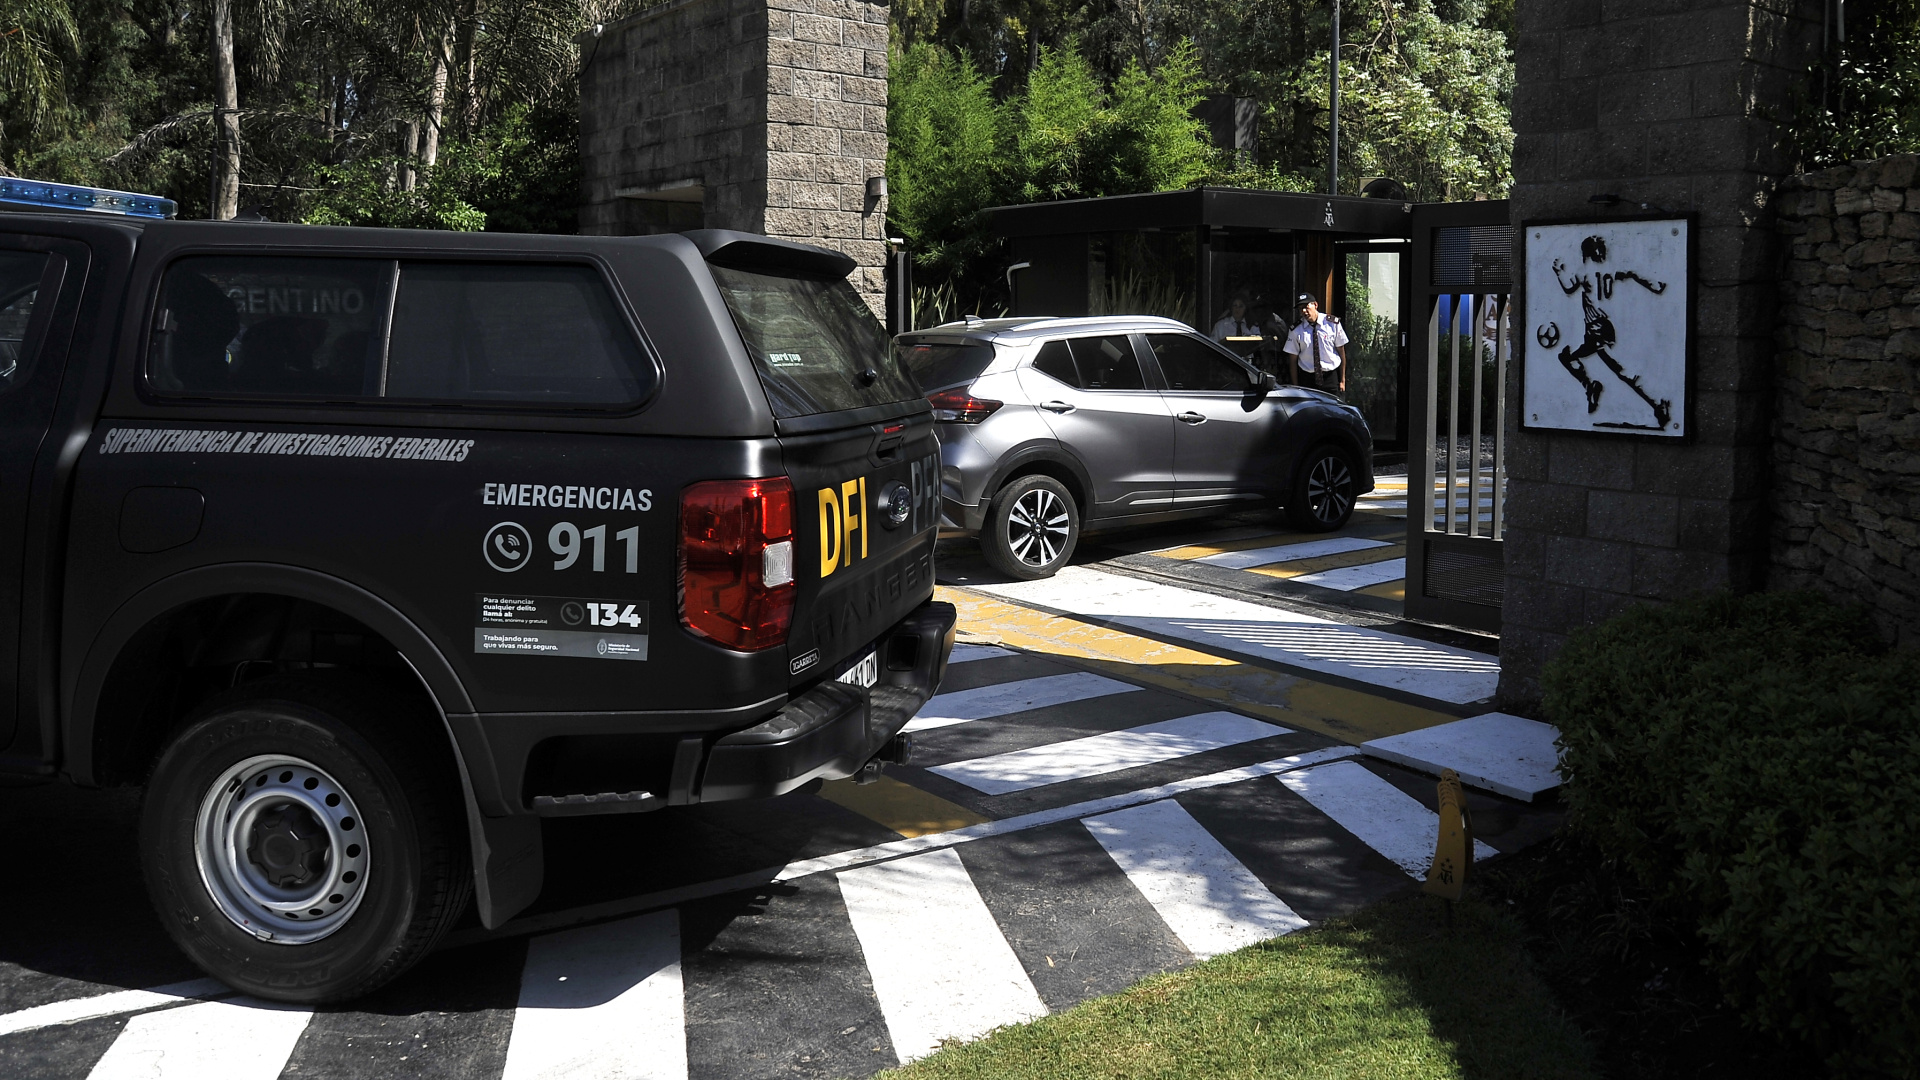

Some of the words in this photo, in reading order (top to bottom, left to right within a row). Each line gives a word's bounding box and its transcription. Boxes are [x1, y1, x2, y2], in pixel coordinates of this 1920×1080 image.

[227, 286, 364, 314] GENTINO
[1595, 272, 1613, 300] 10
[100, 427, 236, 454] SUPERINTENDENCIA
[235, 432, 257, 453] DE
[255, 432, 392, 458] INVESTIGACIONES
[386, 436, 474, 462] FEDERALES
[483, 482, 653, 512] EMERGENCIAS
[817, 476, 869, 579] DFI
[547, 521, 640, 574] 911
[483, 604, 515, 613] cualquier
[586, 602, 642, 628] 134
[483, 634, 522, 643] Trabajando
